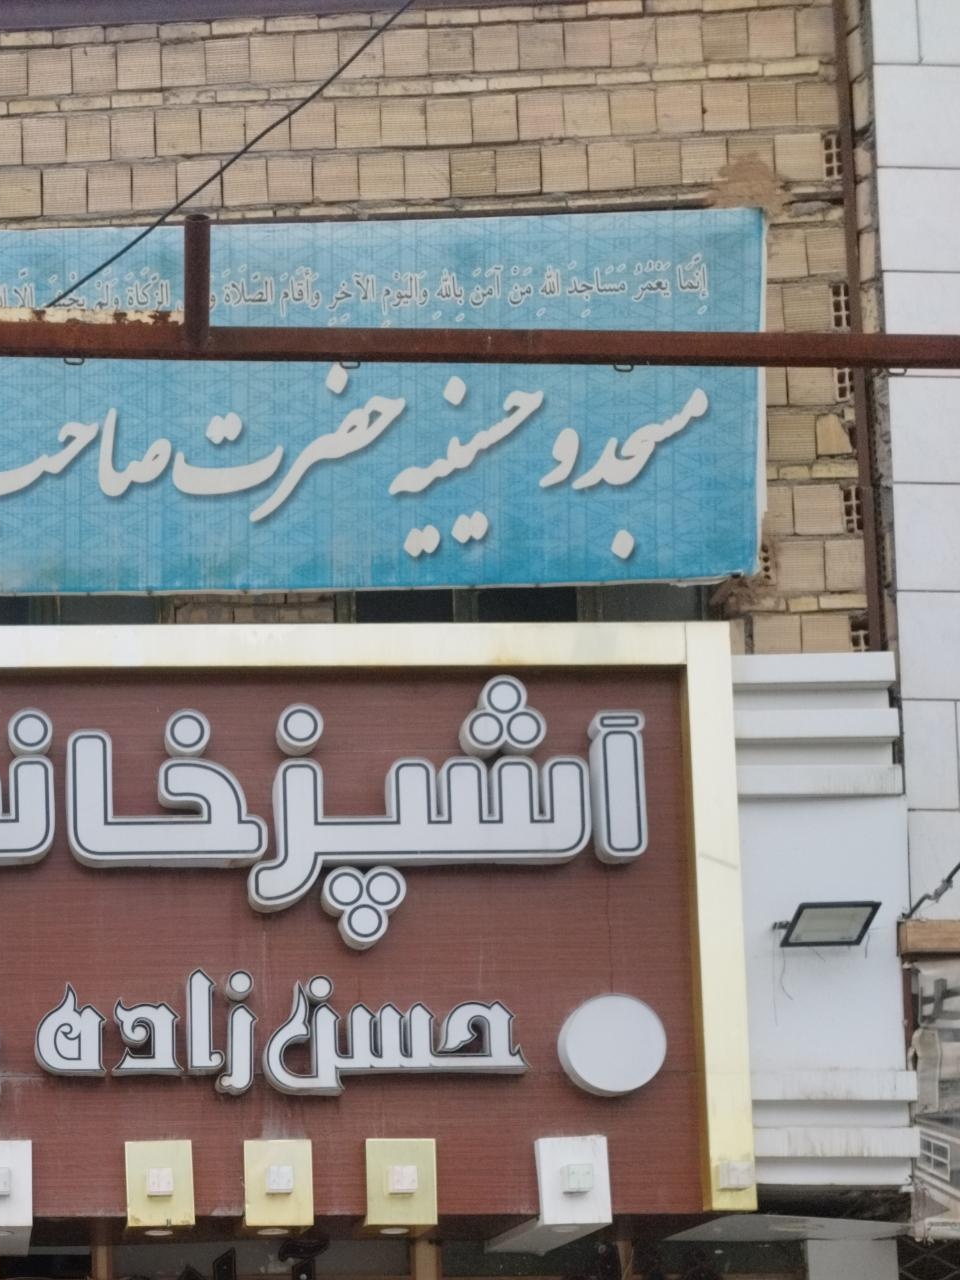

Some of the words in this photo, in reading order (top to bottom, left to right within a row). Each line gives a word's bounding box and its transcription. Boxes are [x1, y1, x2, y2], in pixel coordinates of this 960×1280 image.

[172, 363, 406, 523] حضرت
[540, 427, 579, 488] و
[572, 388, 709, 559] مسجد
